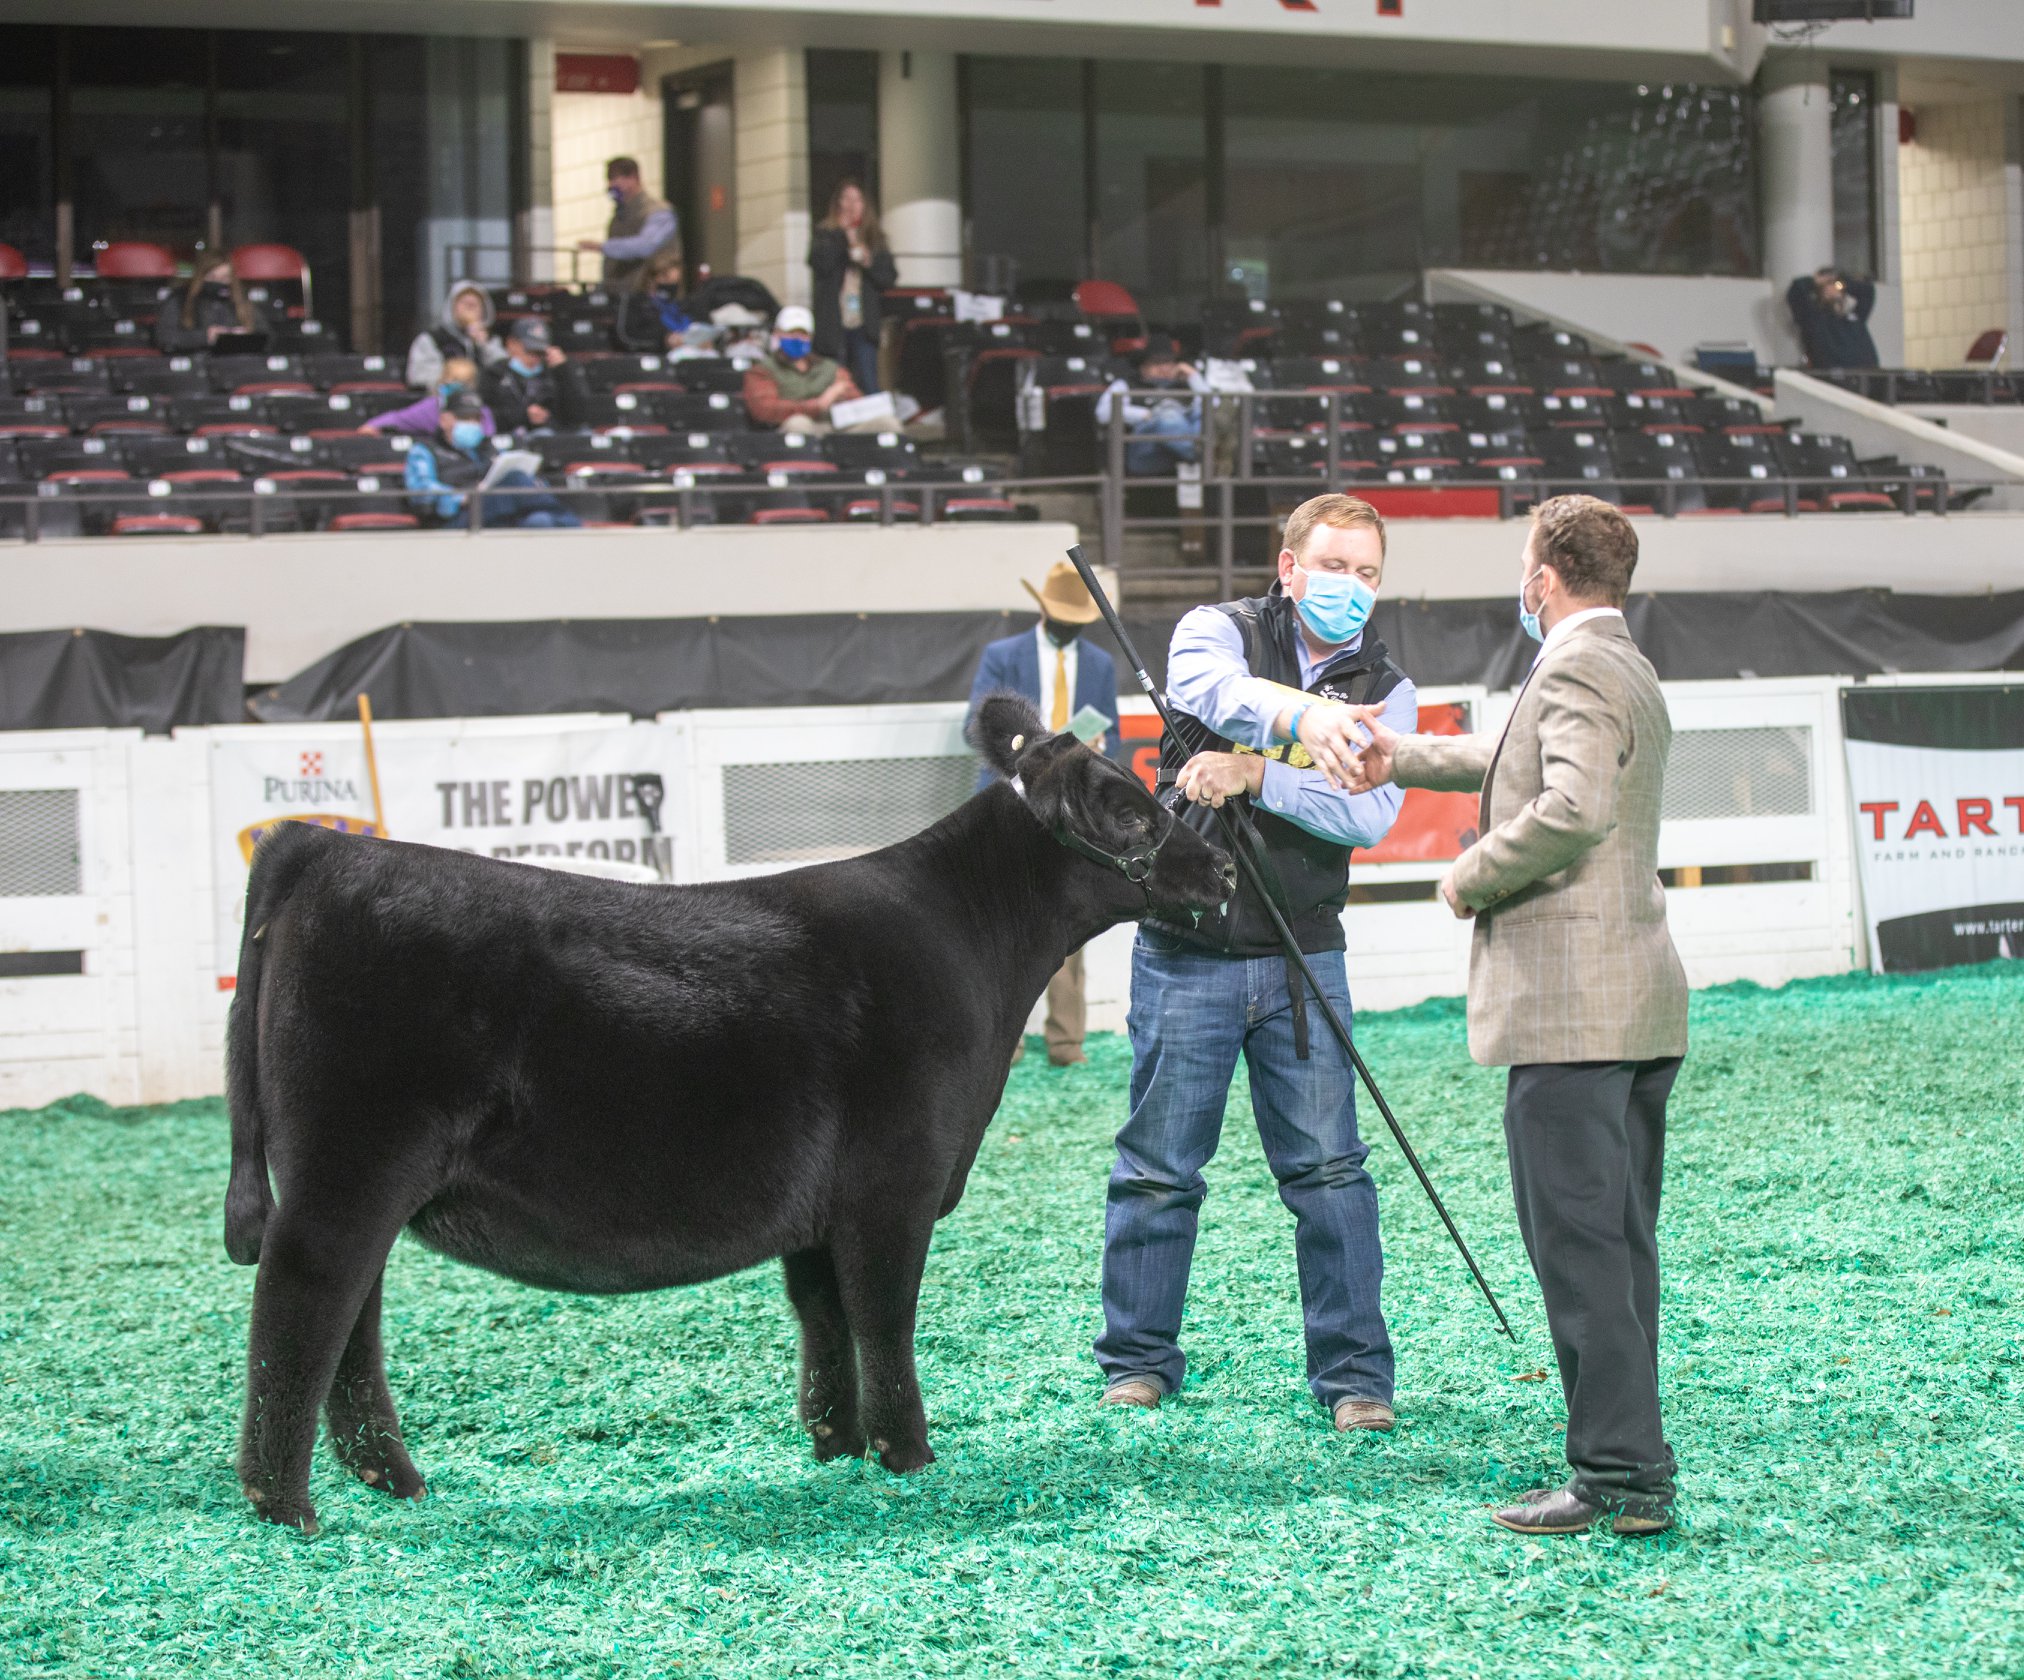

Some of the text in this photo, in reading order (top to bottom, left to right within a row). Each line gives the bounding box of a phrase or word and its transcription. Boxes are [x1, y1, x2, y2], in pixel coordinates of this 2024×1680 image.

[264, 775, 358, 804] PURINA
[436, 773, 663, 828] THE POWE
[1874, 851, 1919, 861] FARM
[1930, 849, 1965, 860] AND
